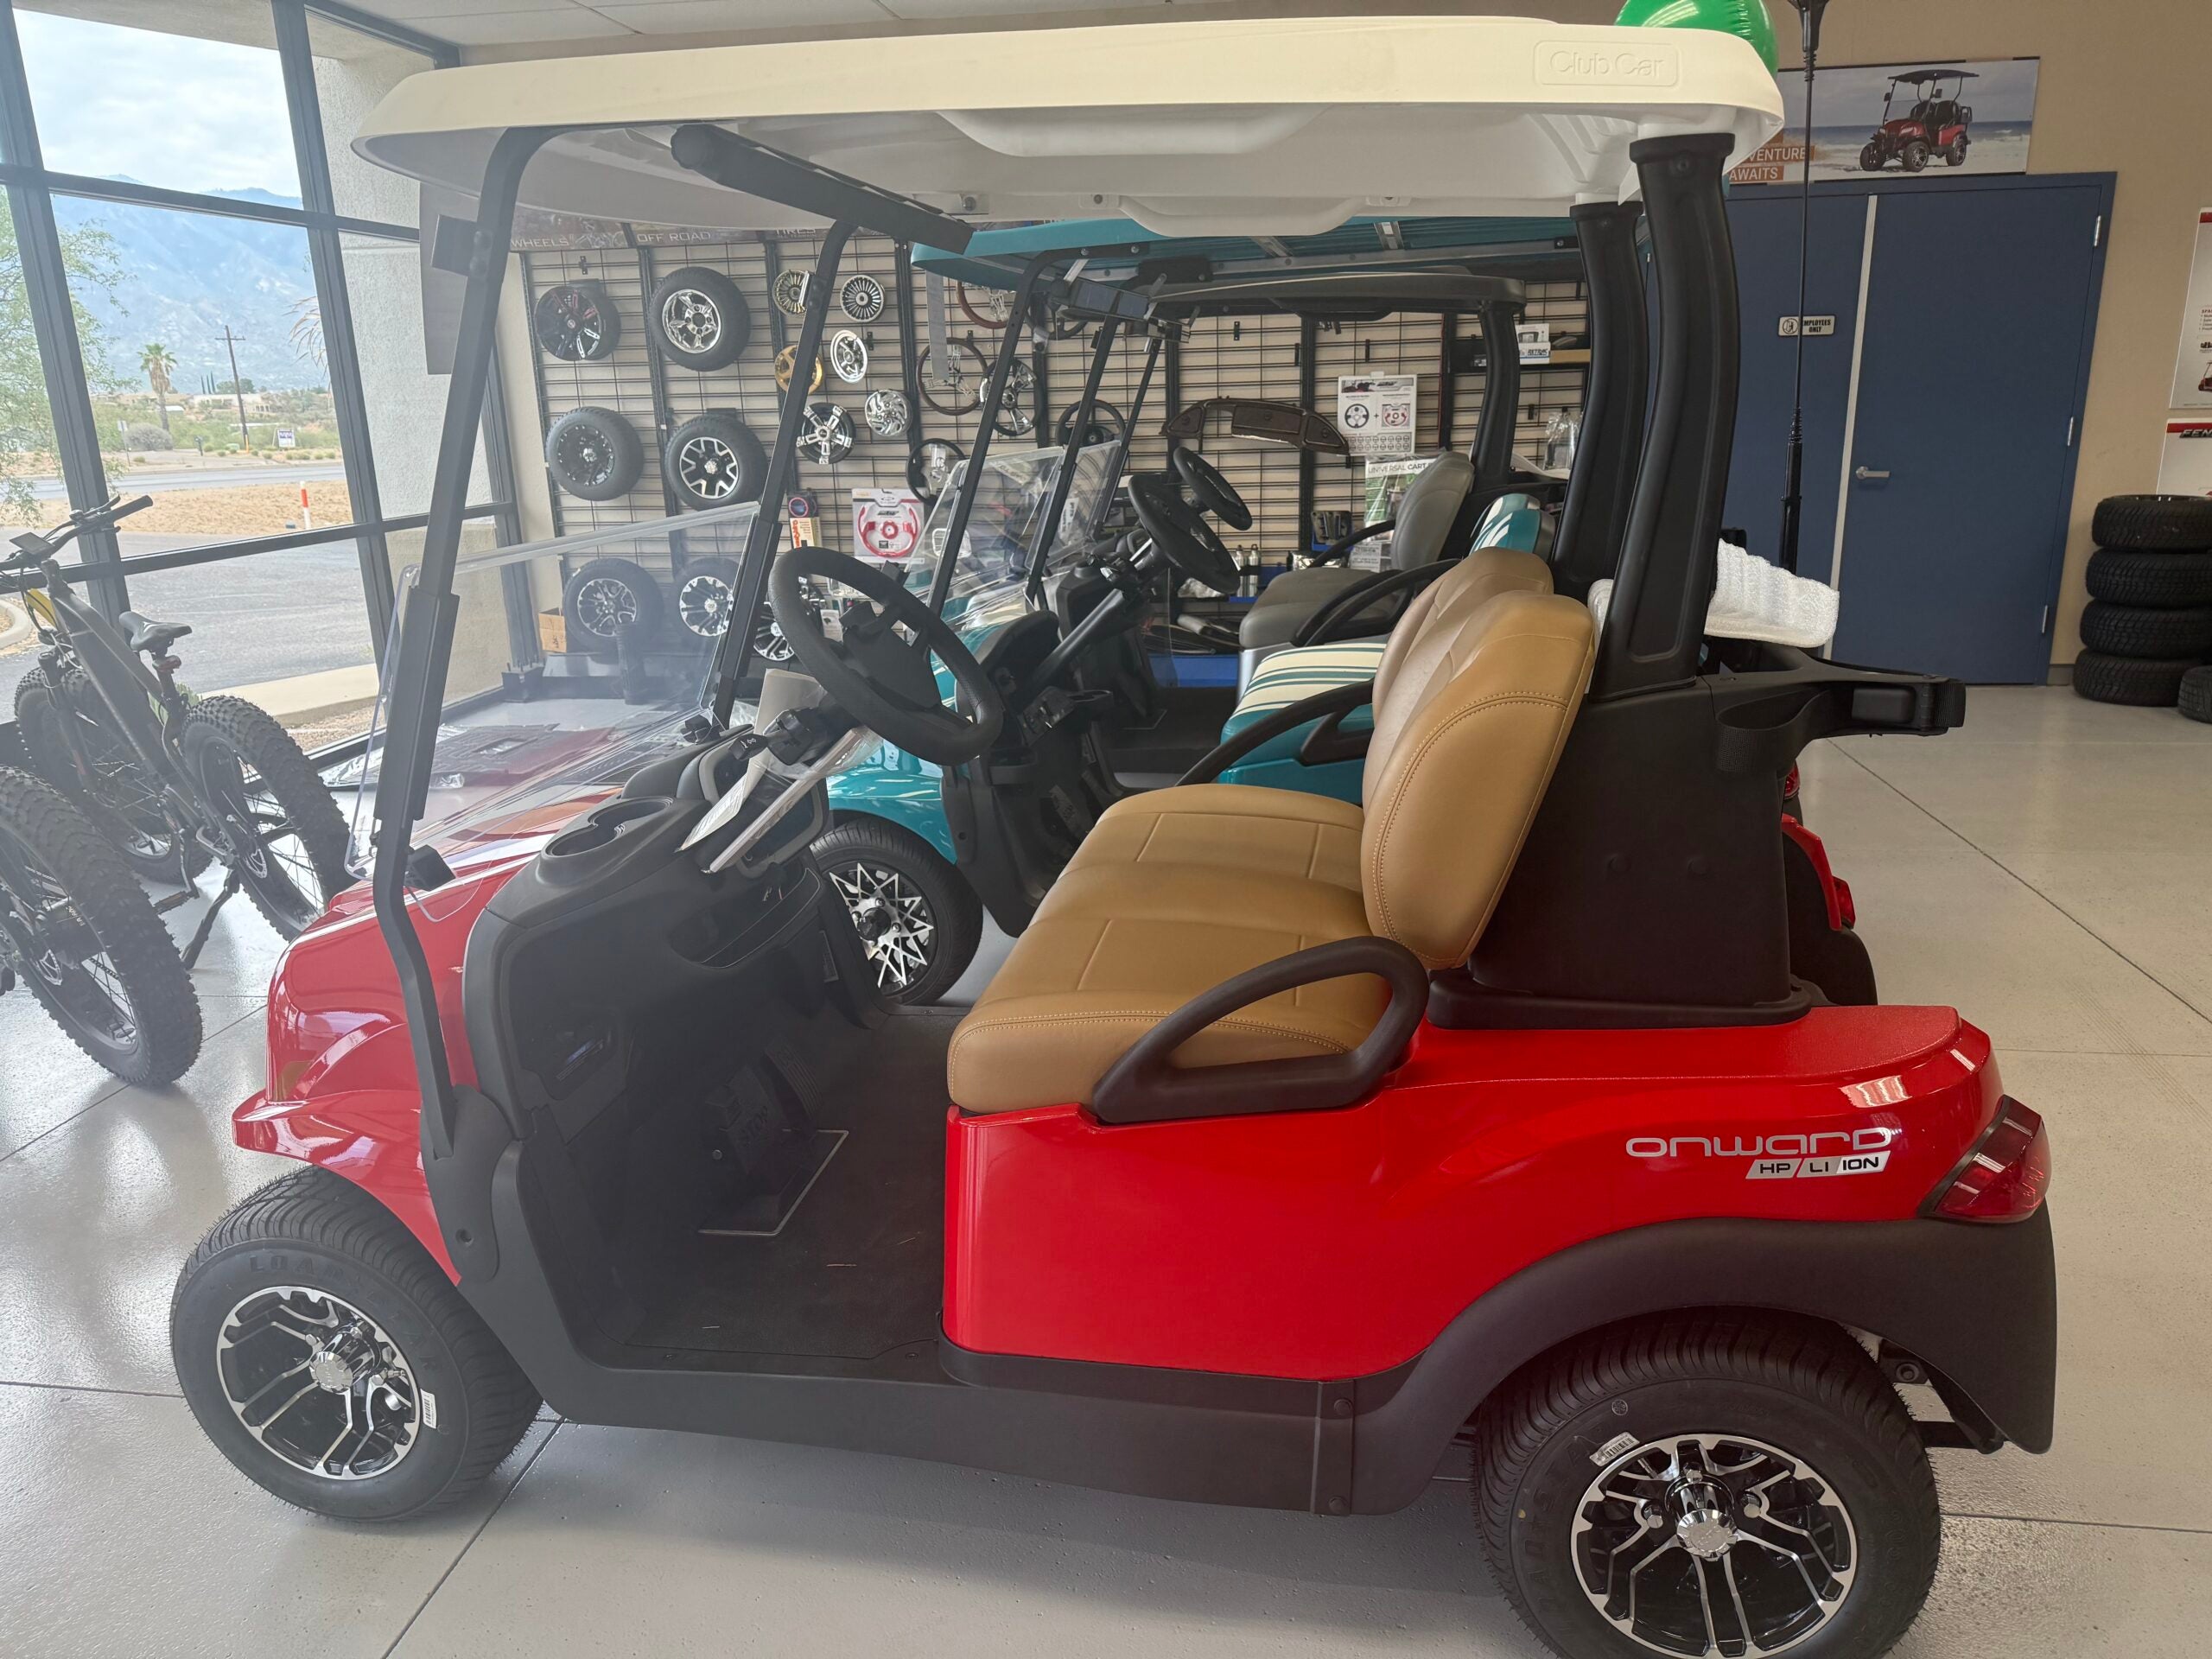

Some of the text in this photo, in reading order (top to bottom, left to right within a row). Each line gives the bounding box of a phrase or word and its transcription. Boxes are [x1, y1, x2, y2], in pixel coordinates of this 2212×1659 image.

[1549, 50, 1664, 78] Club Car
[1750, 147, 1806, 162] VENTURE
[1729, 167, 1778, 181] AWAITS
[511, 238, 570, 248] WHEELS
[636, 231, 711, 243] OFF ROAD
[2180, 429, 2212, 438] FEN
[1368, 465, 1407, 474] UNIVERSAL
[1407, 462, 1427, 471] CART
[1759, 1156, 1879, 1174] HP LI ION
